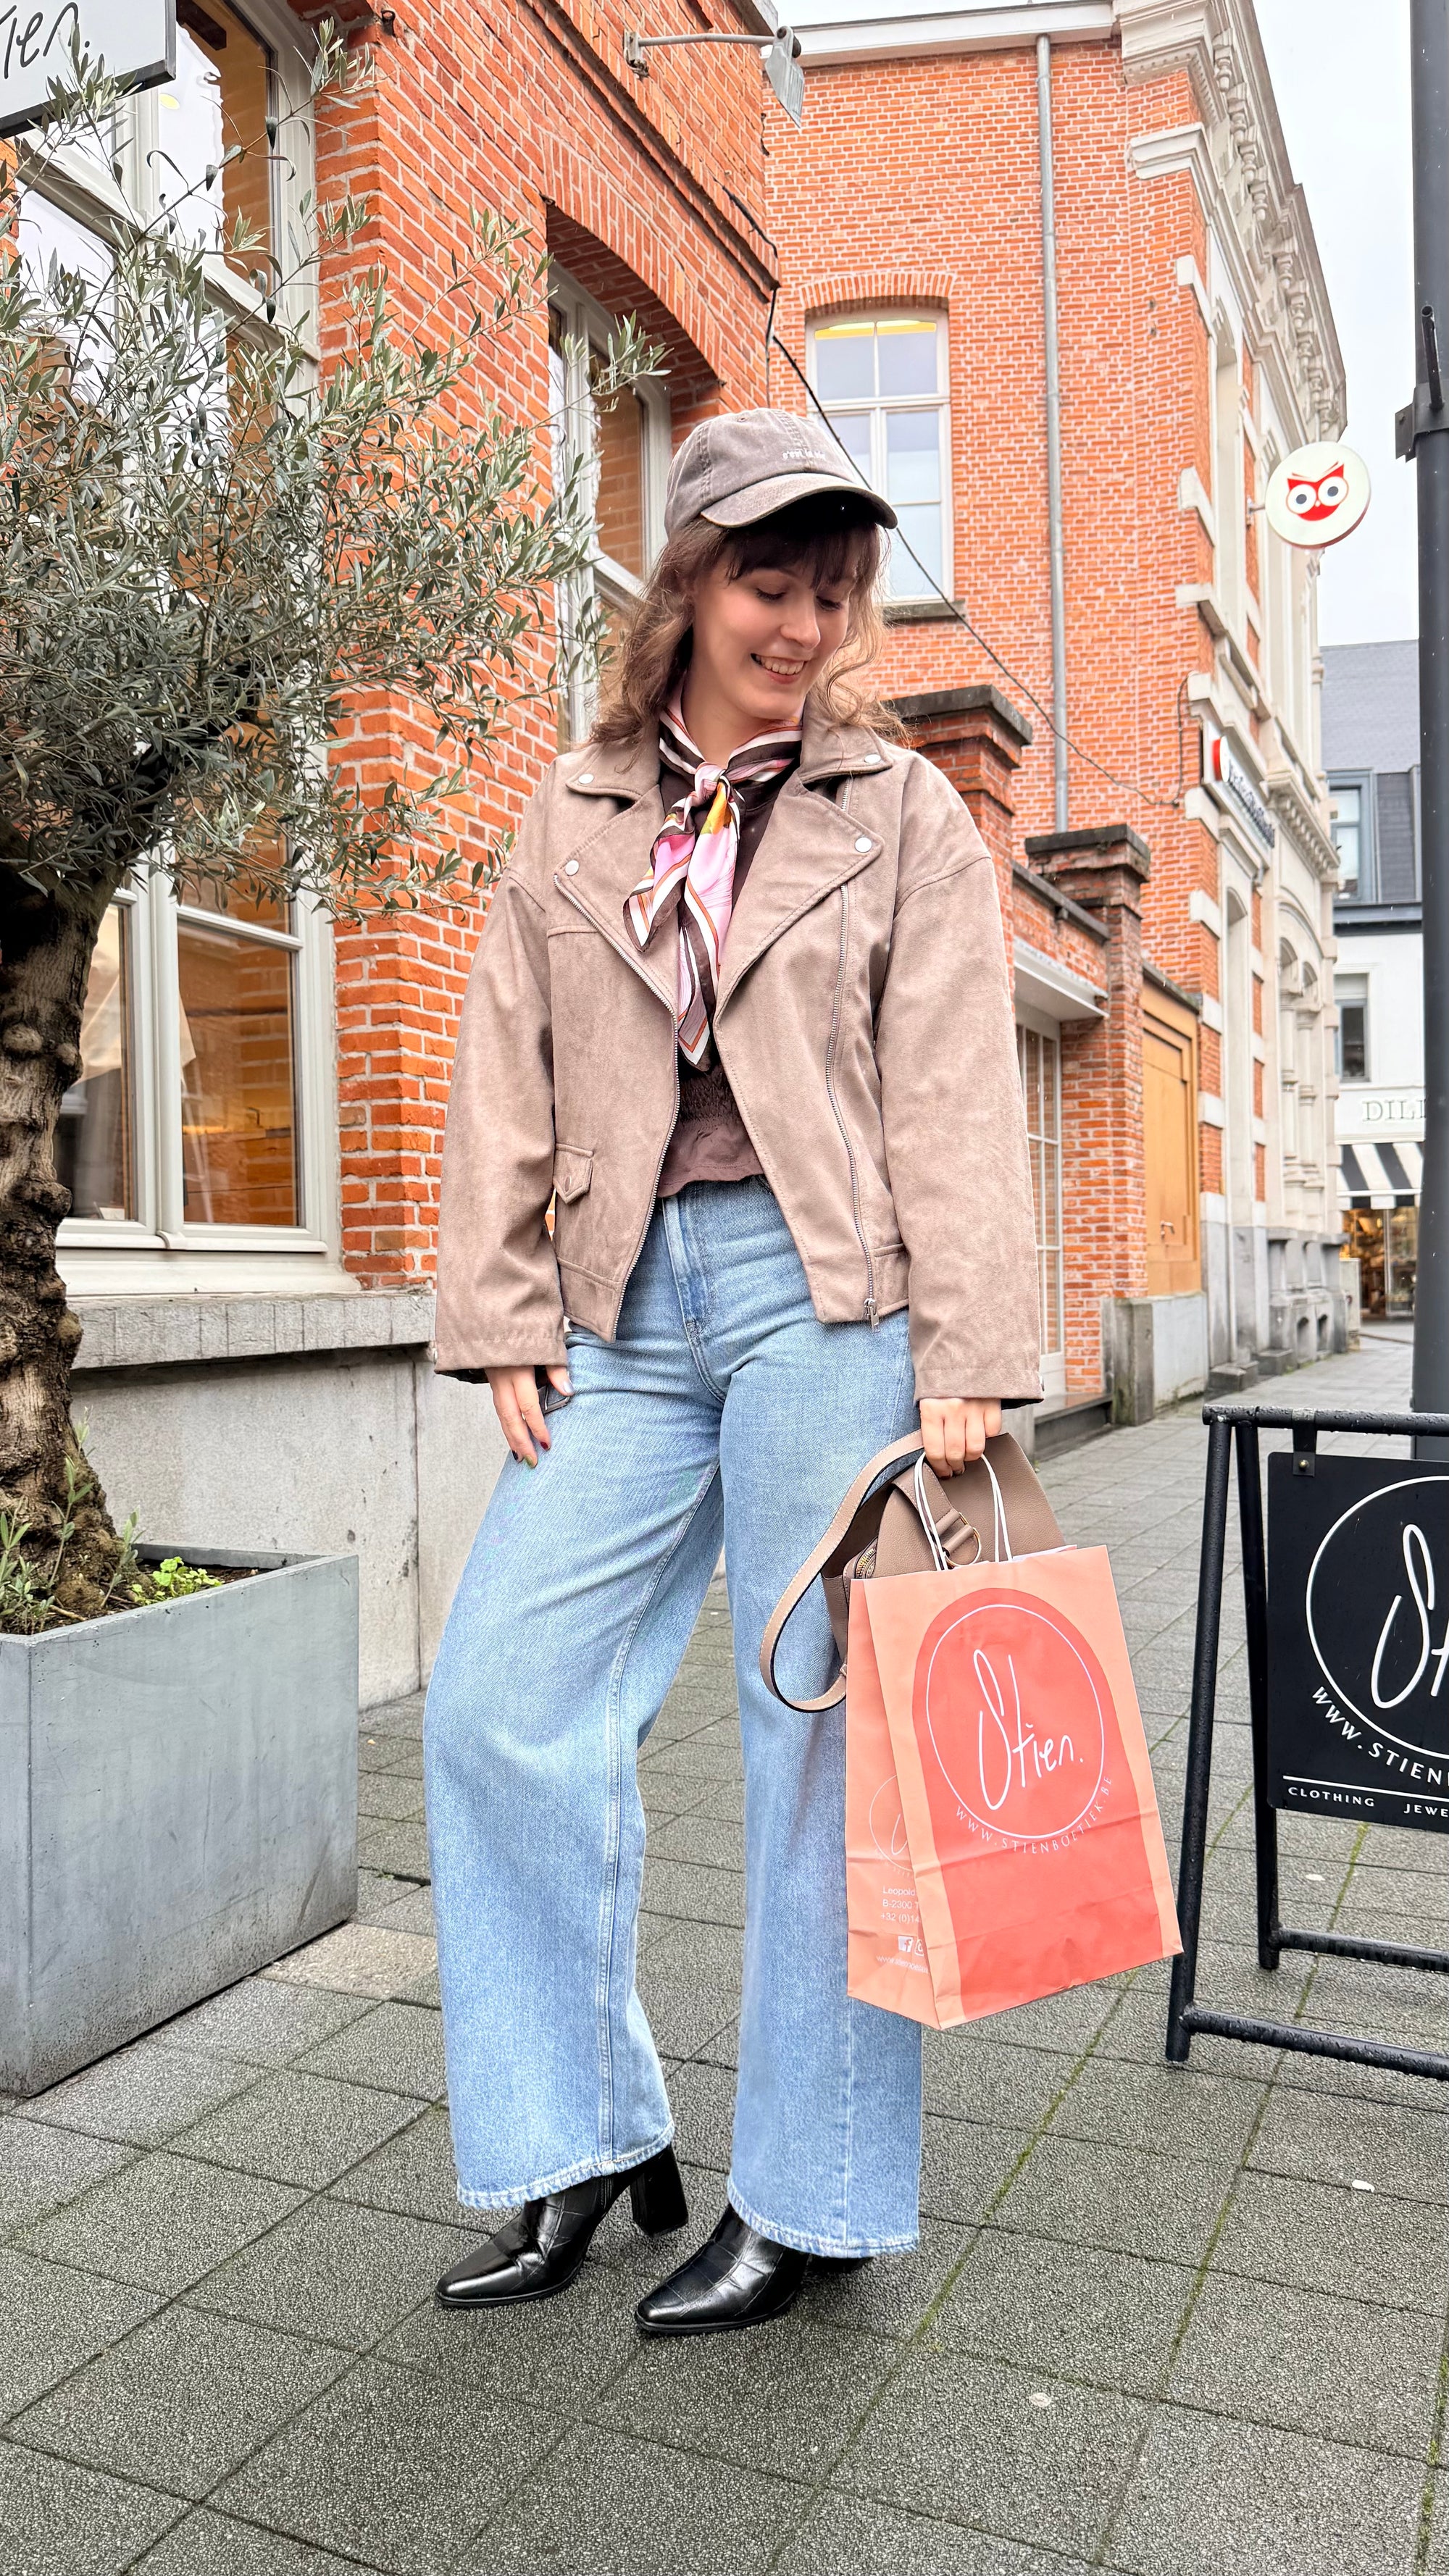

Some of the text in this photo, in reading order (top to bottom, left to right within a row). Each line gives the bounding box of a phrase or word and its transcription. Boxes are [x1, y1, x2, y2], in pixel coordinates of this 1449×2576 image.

[1312, 1686, 1449, 1786] WWW.STIEN
[956, 1776, 1112, 1854] WWW.STIENBOETIEK.BE
[1287, 1786, 1375, 1807] CLOTHING
